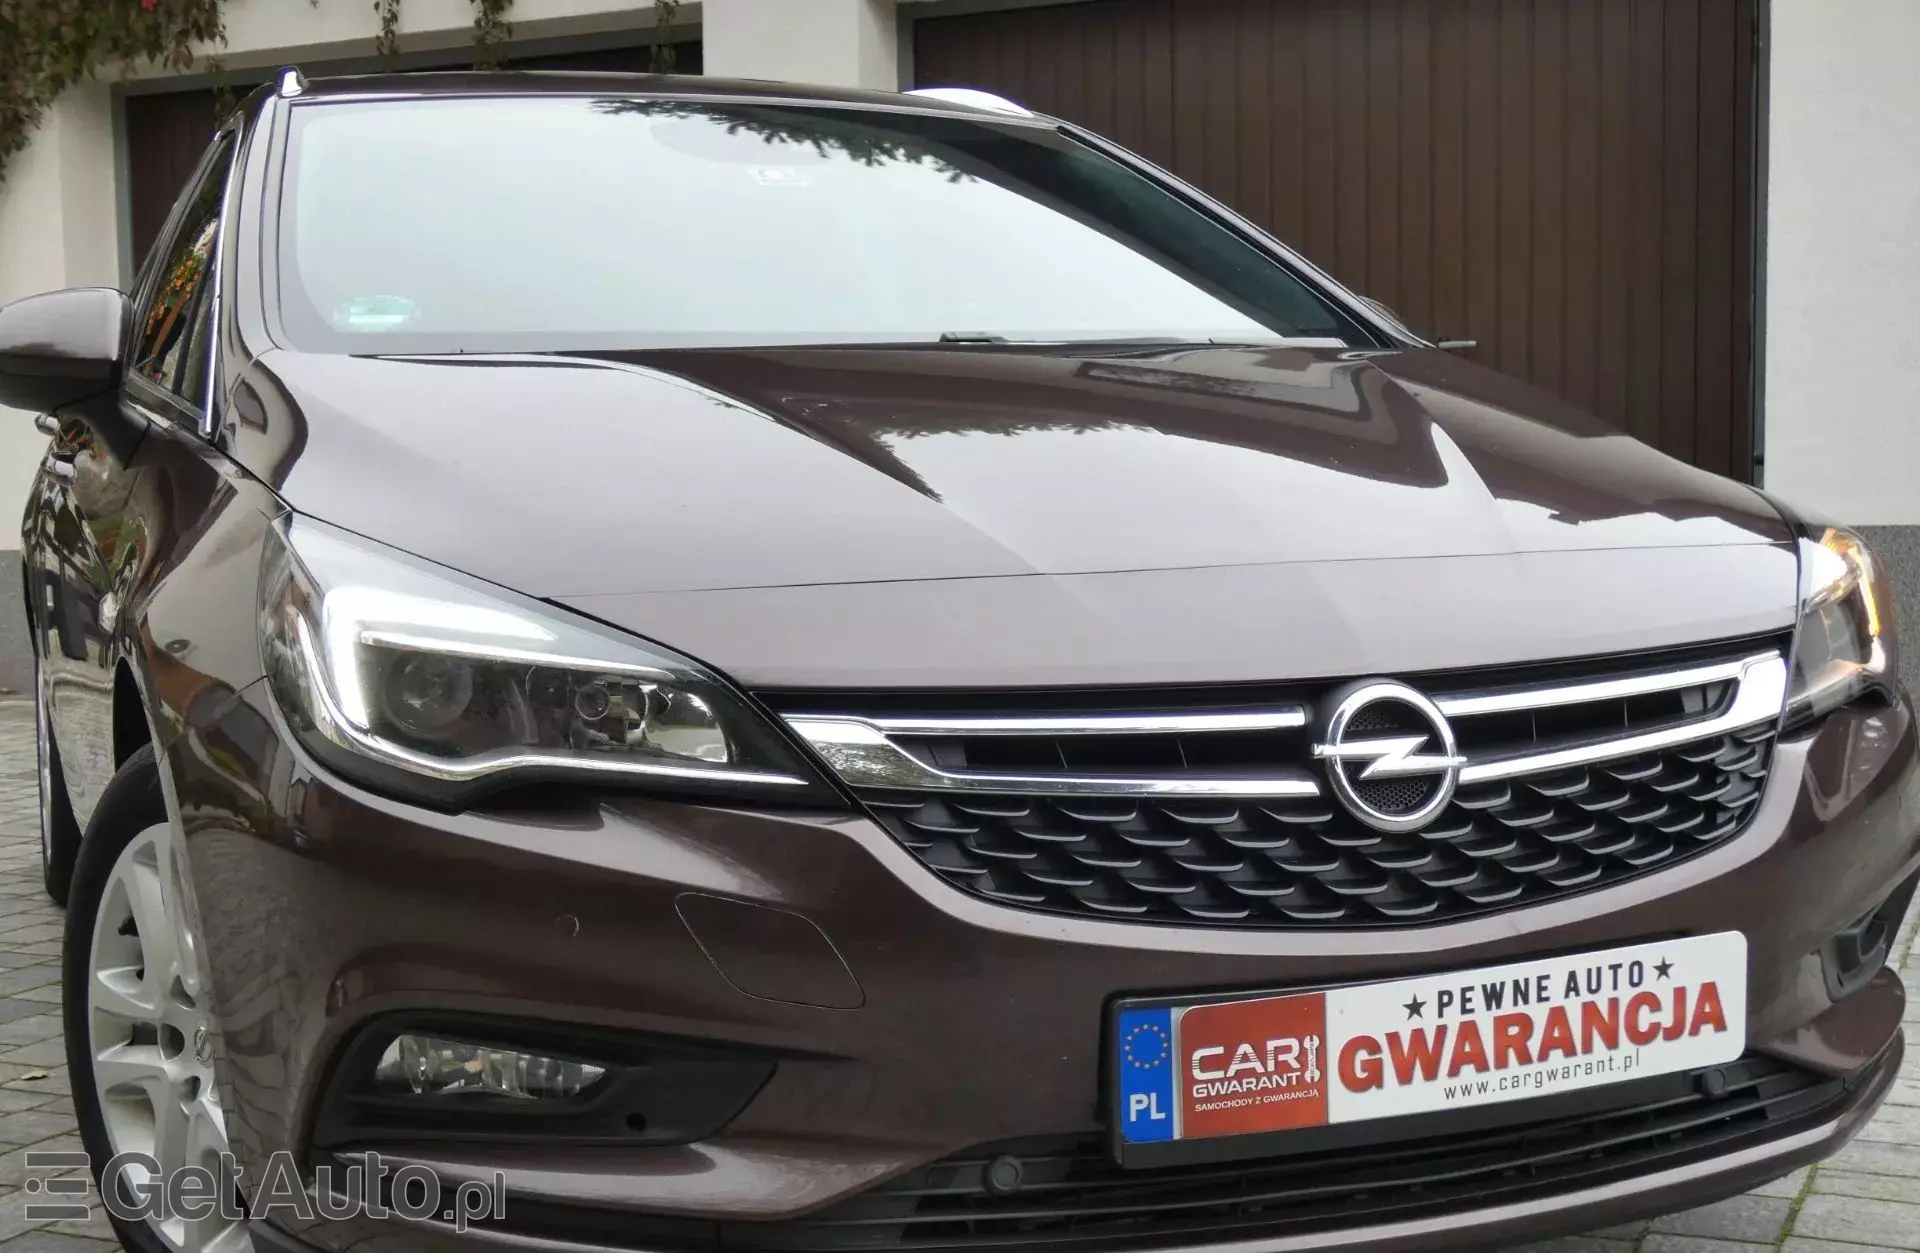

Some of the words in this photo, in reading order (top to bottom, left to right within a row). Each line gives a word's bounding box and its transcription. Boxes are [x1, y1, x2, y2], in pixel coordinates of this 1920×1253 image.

[1438, 974, 1552, 1019] PEWNE
[1564, 960, 1644, 998] AUTO
[1191, 1037, 1302, 1080] CAR
[1337, 980, 1728, 1094] GWARANCJA
[1192, 1072, 1302, 1098] GWARANT
[1443, 1047, 1640, 1101] www.cargwarant.pl
[1129, 1092, 1167, 1122] PL
[1195, 1096, 1253, 1112] SAMOCHODY
[1255, 1096, 1262, 1105] Z
